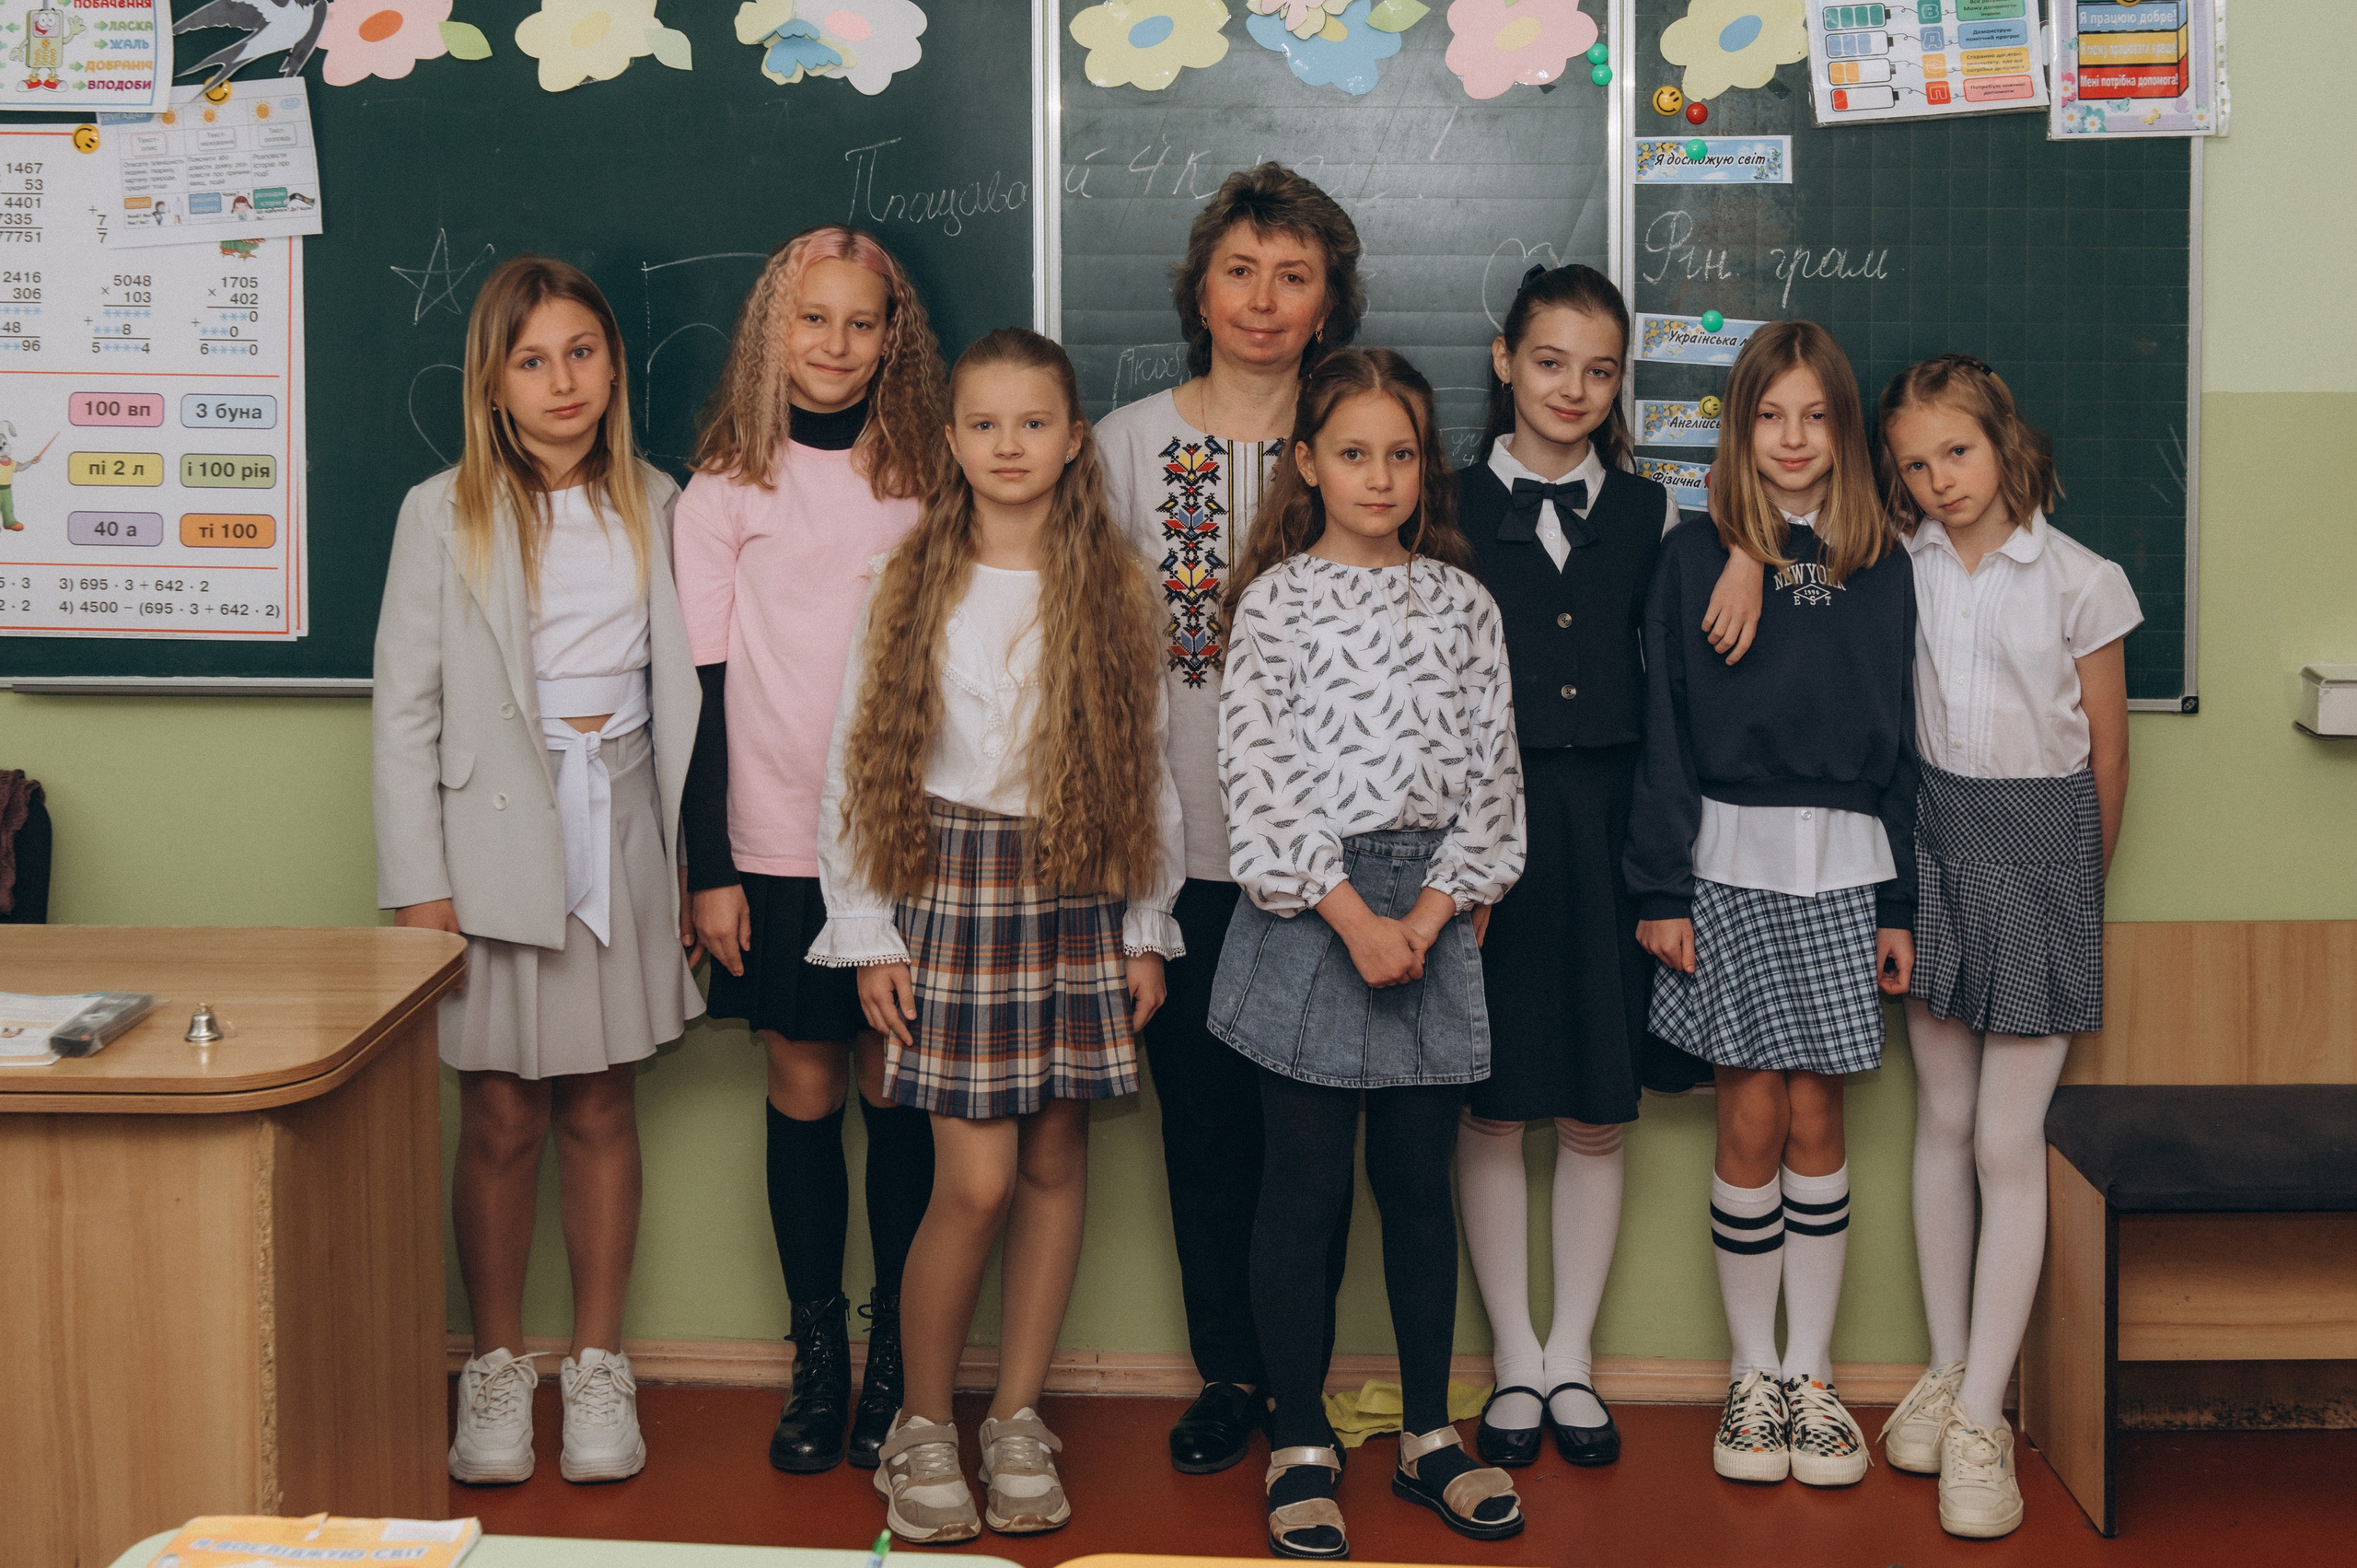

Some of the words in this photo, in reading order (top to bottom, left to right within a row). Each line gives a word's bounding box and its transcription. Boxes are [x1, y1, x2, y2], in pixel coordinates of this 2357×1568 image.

[2079, 11, 2087, 24] Я
[2089, 13, 2137, 27] працюю
[2139, 9, 2177, 26] добре!
[108, 20, 154, 31] ЛАСКА
[110, 39, 149, 50] ЖАЛЬ
[84, 60, 154, 73] ДОБРАНІЧ
[87, 80, 152, 92] ВПОДОБИ
[2080, 75, 2100, 87] Мені
[2101, 74, 2137, 89] потрібна
[2137, 73, 2179, 88] допомога!
[1655, 151, 1665, 166] Я
[1737, 151, 1767, 166] світ
[6, 162, 43, 175] 1467
[24, 178, 43, 191] 53
[4, 196, 41, 209] 4401
[3, 271, 41, 284] 2416
[112, 274, 152, 287] 5048
[220, 276, 259, 289] 1705
[12, 287, 41, 300] 306
[123, 291, 152, 304] 103
[229, 293, 259, 305] 402
[1667, 330, 1738, 348] Українська
[84, 401, 121, 416] 100
[128, 403, 151, 417] вп
[215, 402, 263, 424] буна
[88, 460, 106, 476] пі
[113, 460, 125, 476] 2
[133, 463, 145, 476] л
[187, 462, 192, 477] і
[199, 462, 236, 478] 100
[240, 463, 271, 482] рія
[1652, 470, 1702, 489] Фізична
[93, 521, 119, 537] 40
[125, 524, 137, 537] а
[199, 523, 215, 539] ті
[220, 523, 259, 540] 100
[21, 576, 30, 590] 3
[59, 577, 74, 592] 3)
[79, 578, 109, 591] 695
[124, 579, 134, 592] 3
[155, 579, 184, 592] 642
[200, 580, 210, 593] 2
[21, 599, 30, 612] 2
[59, 599, 74, 615] 4)
[79, 600, 119, 614] 4500
[138, 601, 174, 617] (695
[189, 602, 200, 615] 3
[219, 604, 250, 617] 642
[265, 605, 281, 620] 2)
